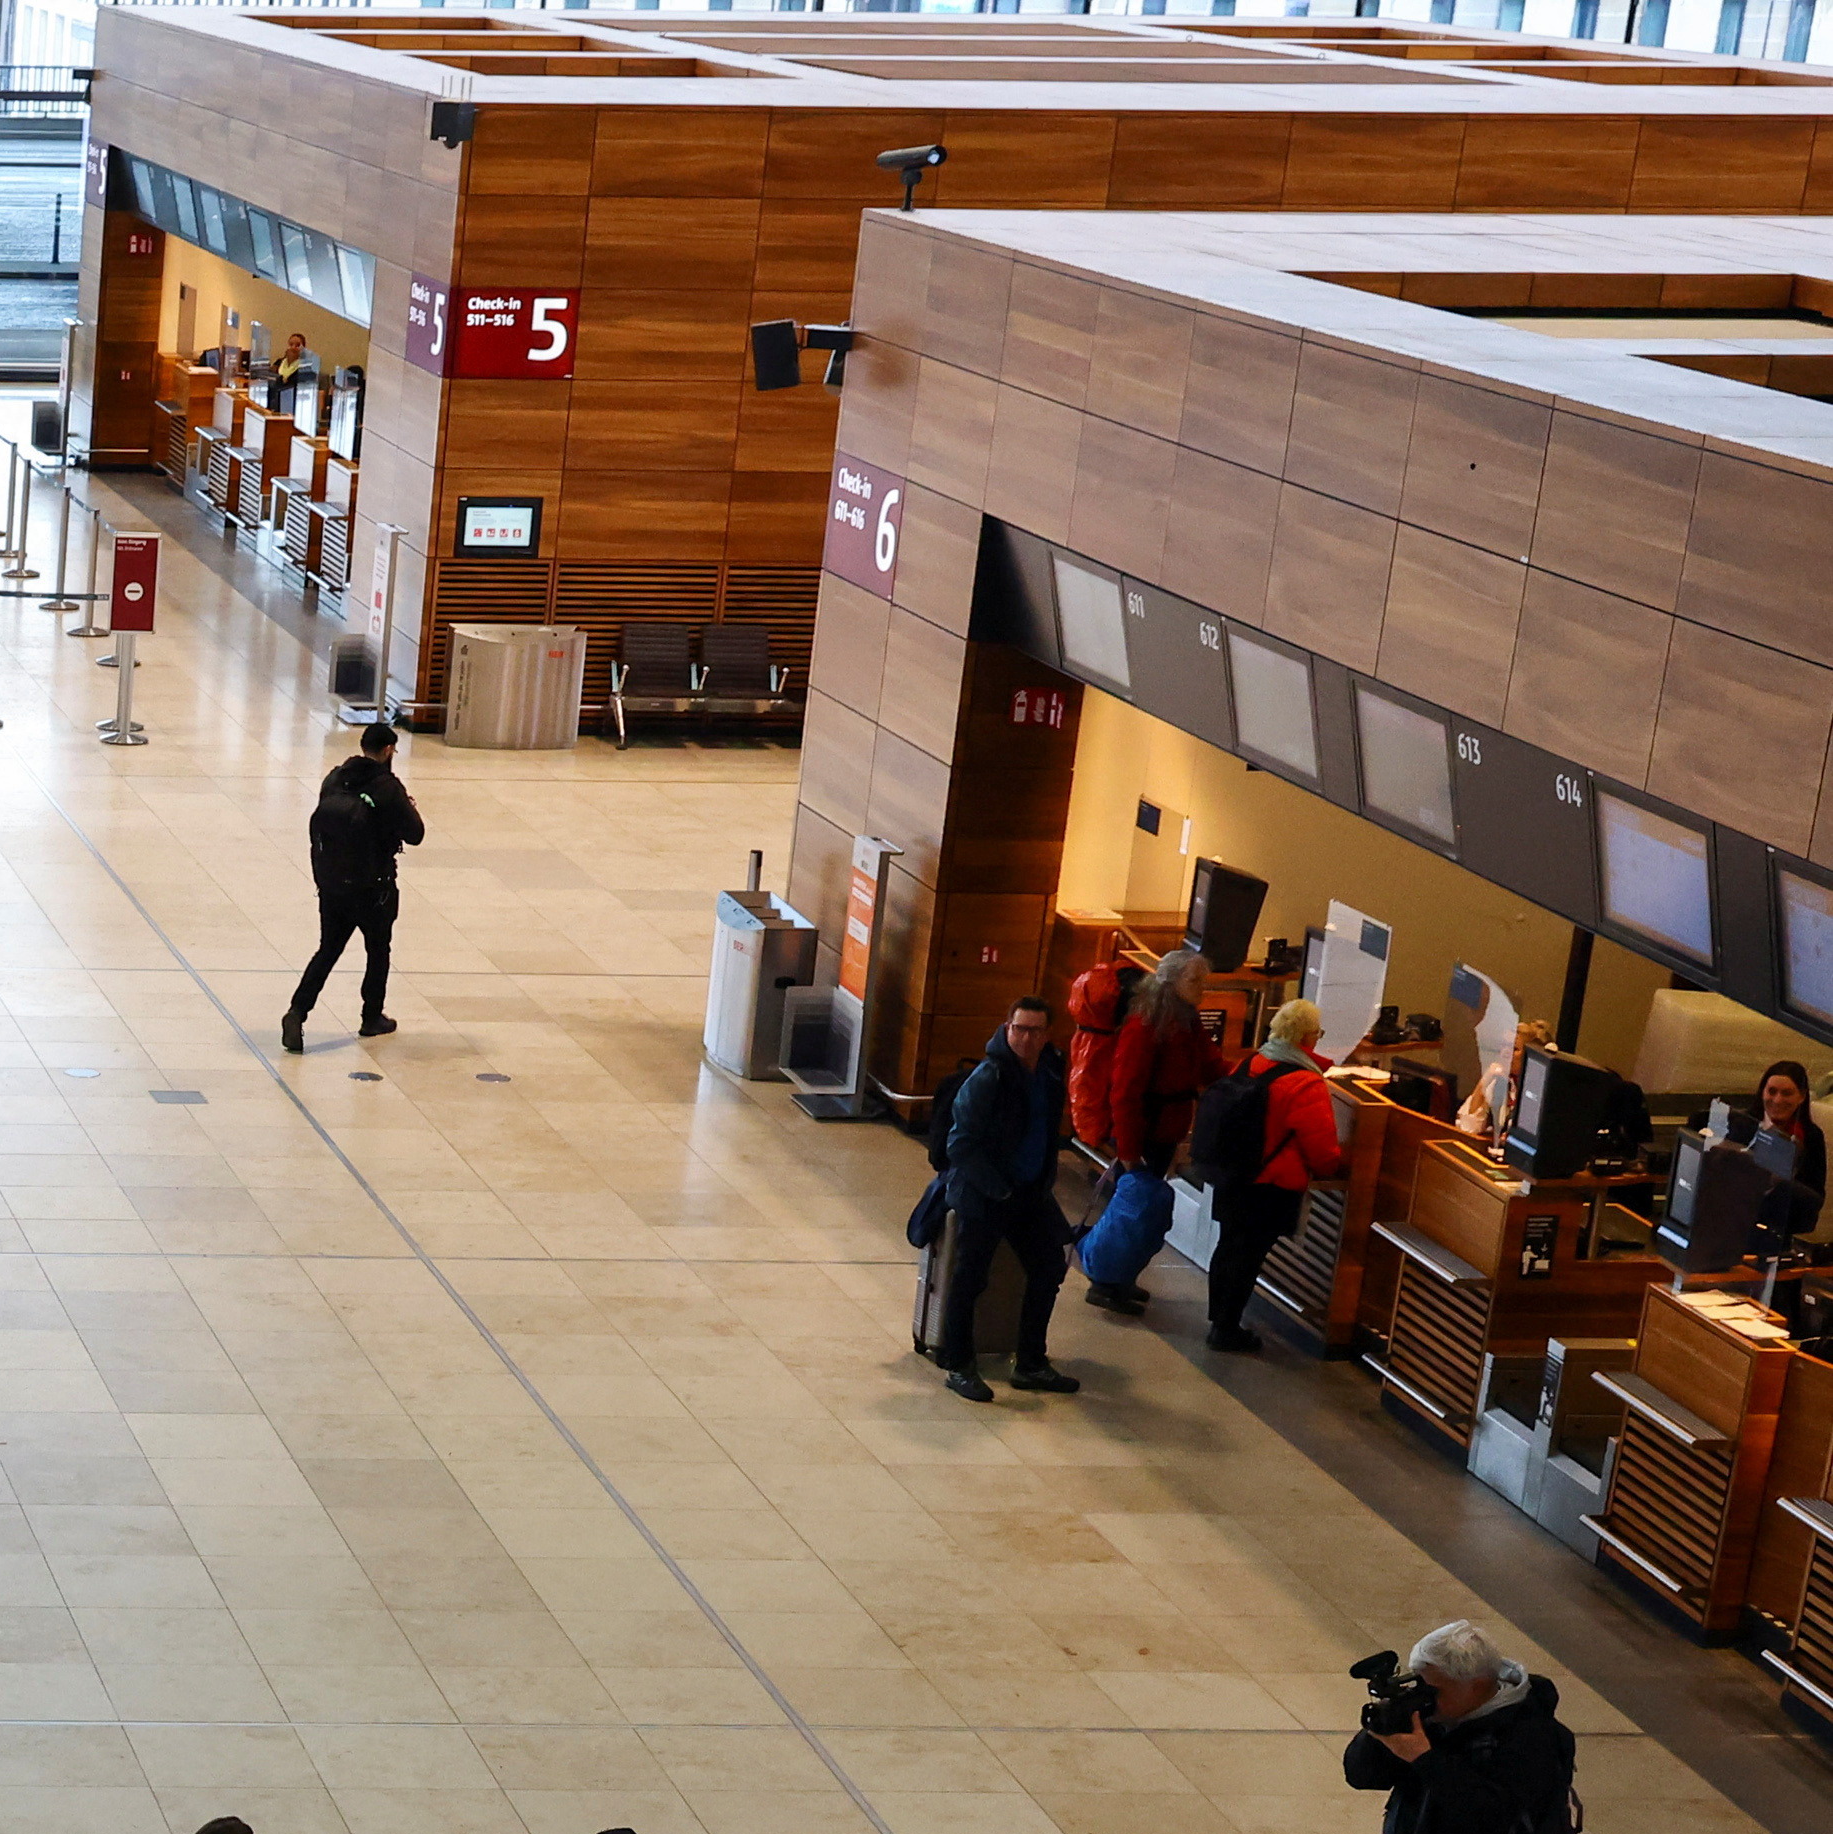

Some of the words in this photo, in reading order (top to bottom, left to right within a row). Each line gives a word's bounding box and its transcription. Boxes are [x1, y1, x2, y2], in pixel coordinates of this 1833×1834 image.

[98, 149, 107, 194] 5
[468, 297, 521, 310] Check-in
[430, 292, 446, 355] 5
[527, 297, 568, 361] 5
[838, 467, 872, 500] Check-in
[875, 489, 899, 572] 6
[1128, 592, 1145, 619] 611
[1199, 621, 1220, 650] 612
[1457, 733, 1481, 765] 613
[1555, 773, 1582, 808] 614
